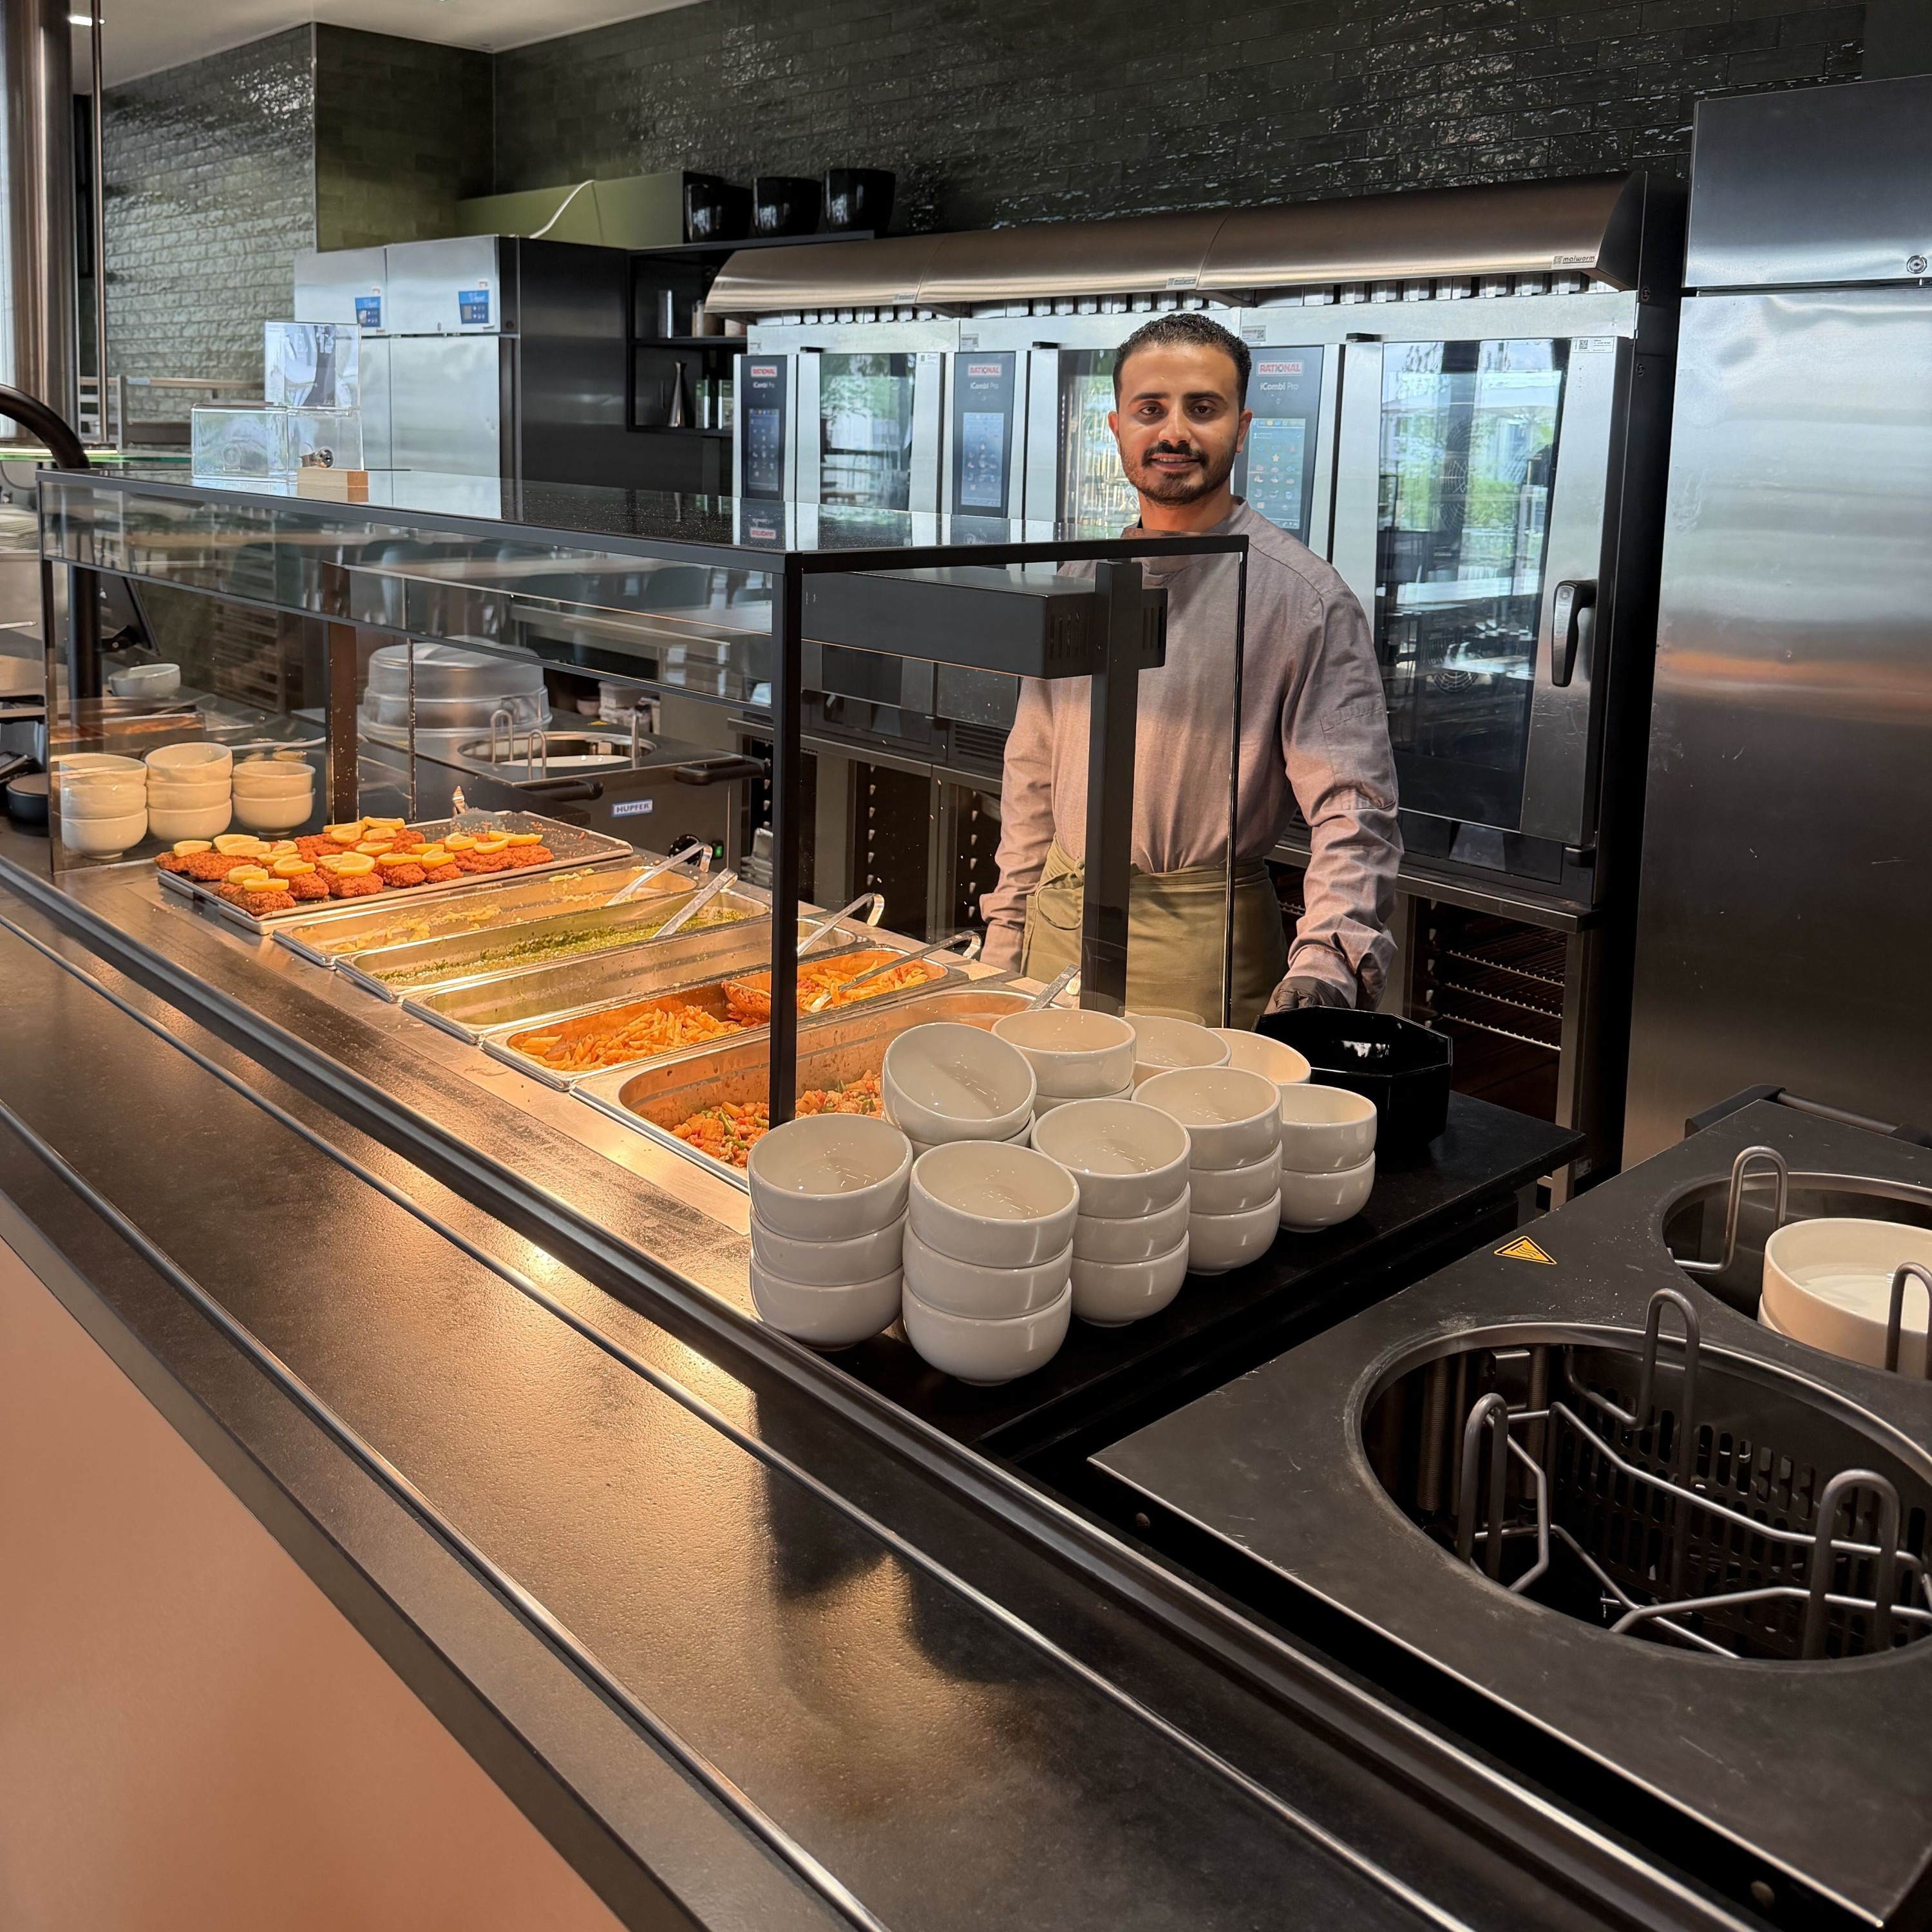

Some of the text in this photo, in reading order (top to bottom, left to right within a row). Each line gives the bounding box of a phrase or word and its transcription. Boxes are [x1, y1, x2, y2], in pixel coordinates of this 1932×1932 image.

[1260, 364, 1301, 373] RATIONAL
[1260, 382, 1299, 390] iCombi Pro
[616, 802, 650, 813] HUPFER
